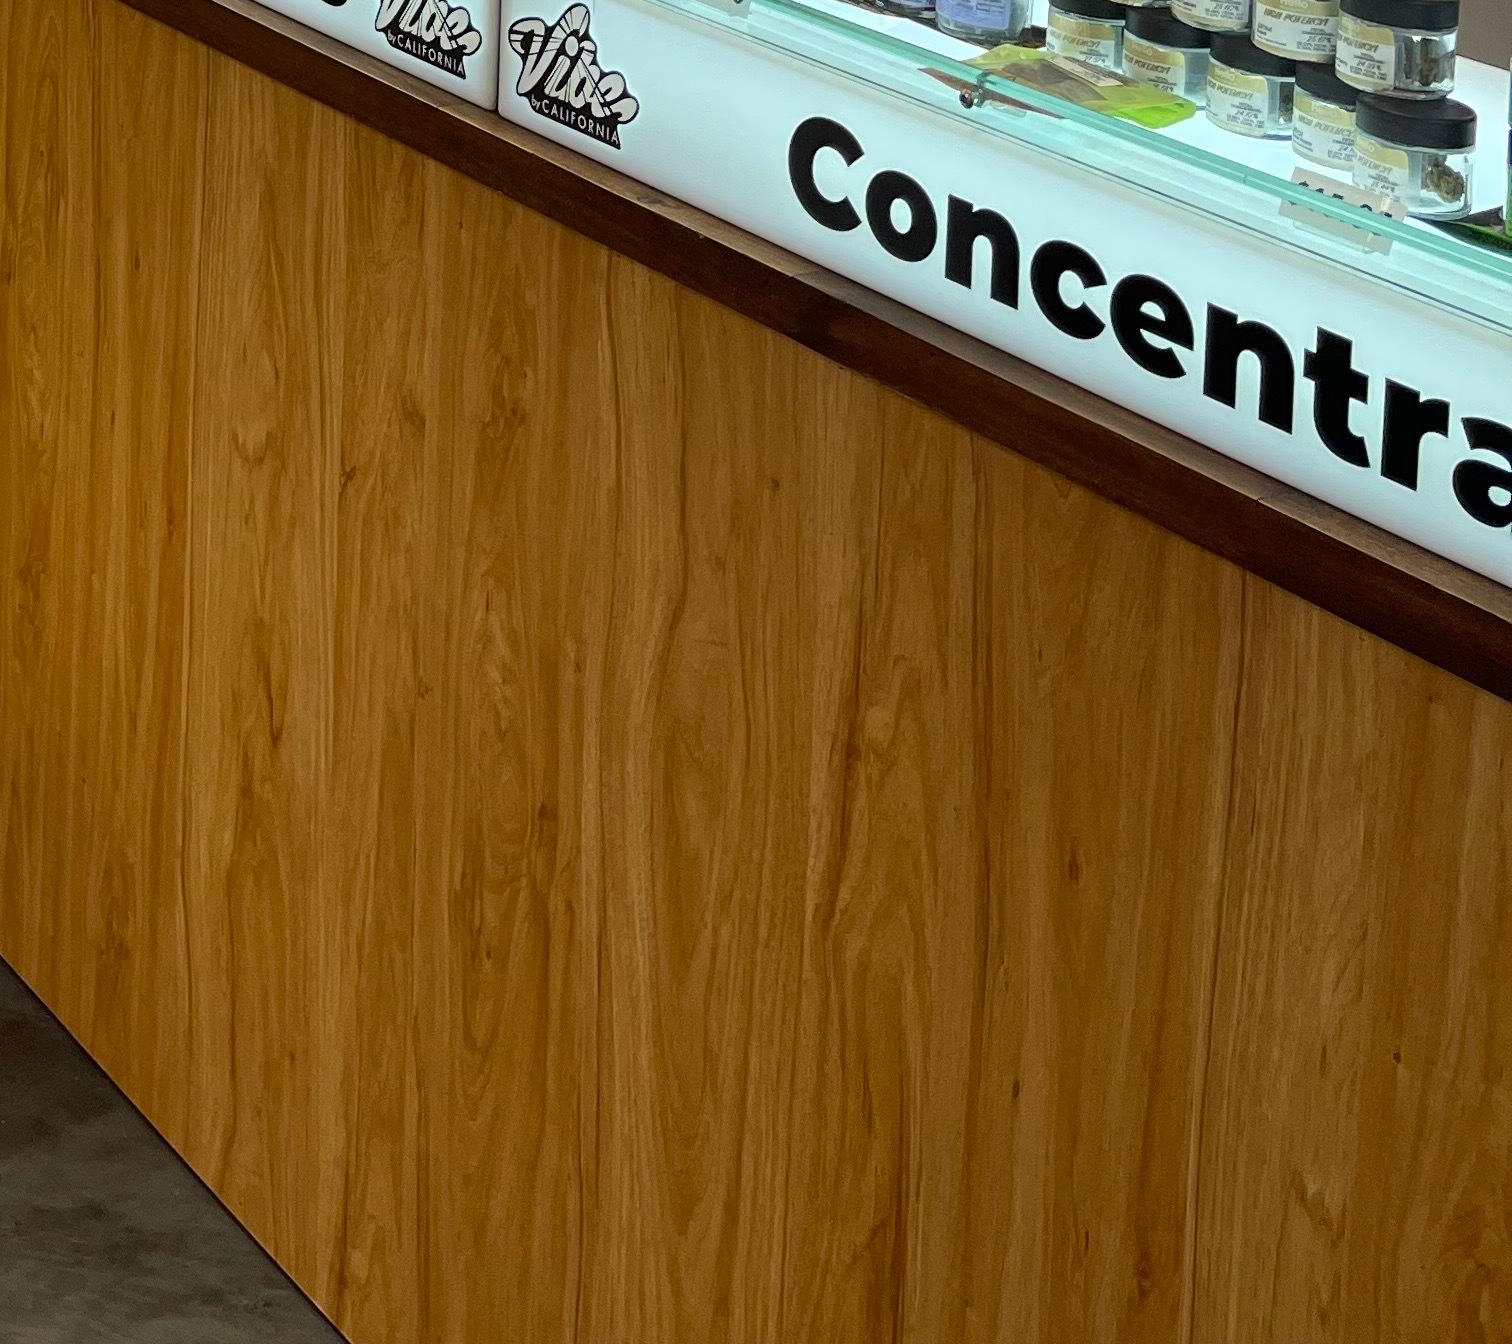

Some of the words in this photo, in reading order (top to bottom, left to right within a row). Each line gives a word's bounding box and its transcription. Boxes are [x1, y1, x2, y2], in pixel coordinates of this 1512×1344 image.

[397, 31, 465, 74] CALIFORNIA
[509, 3, 639, 124] Vibe
[542, 97, 619, 145] CALIFORNIA
[788, 117, 1512, 529] Concentra
